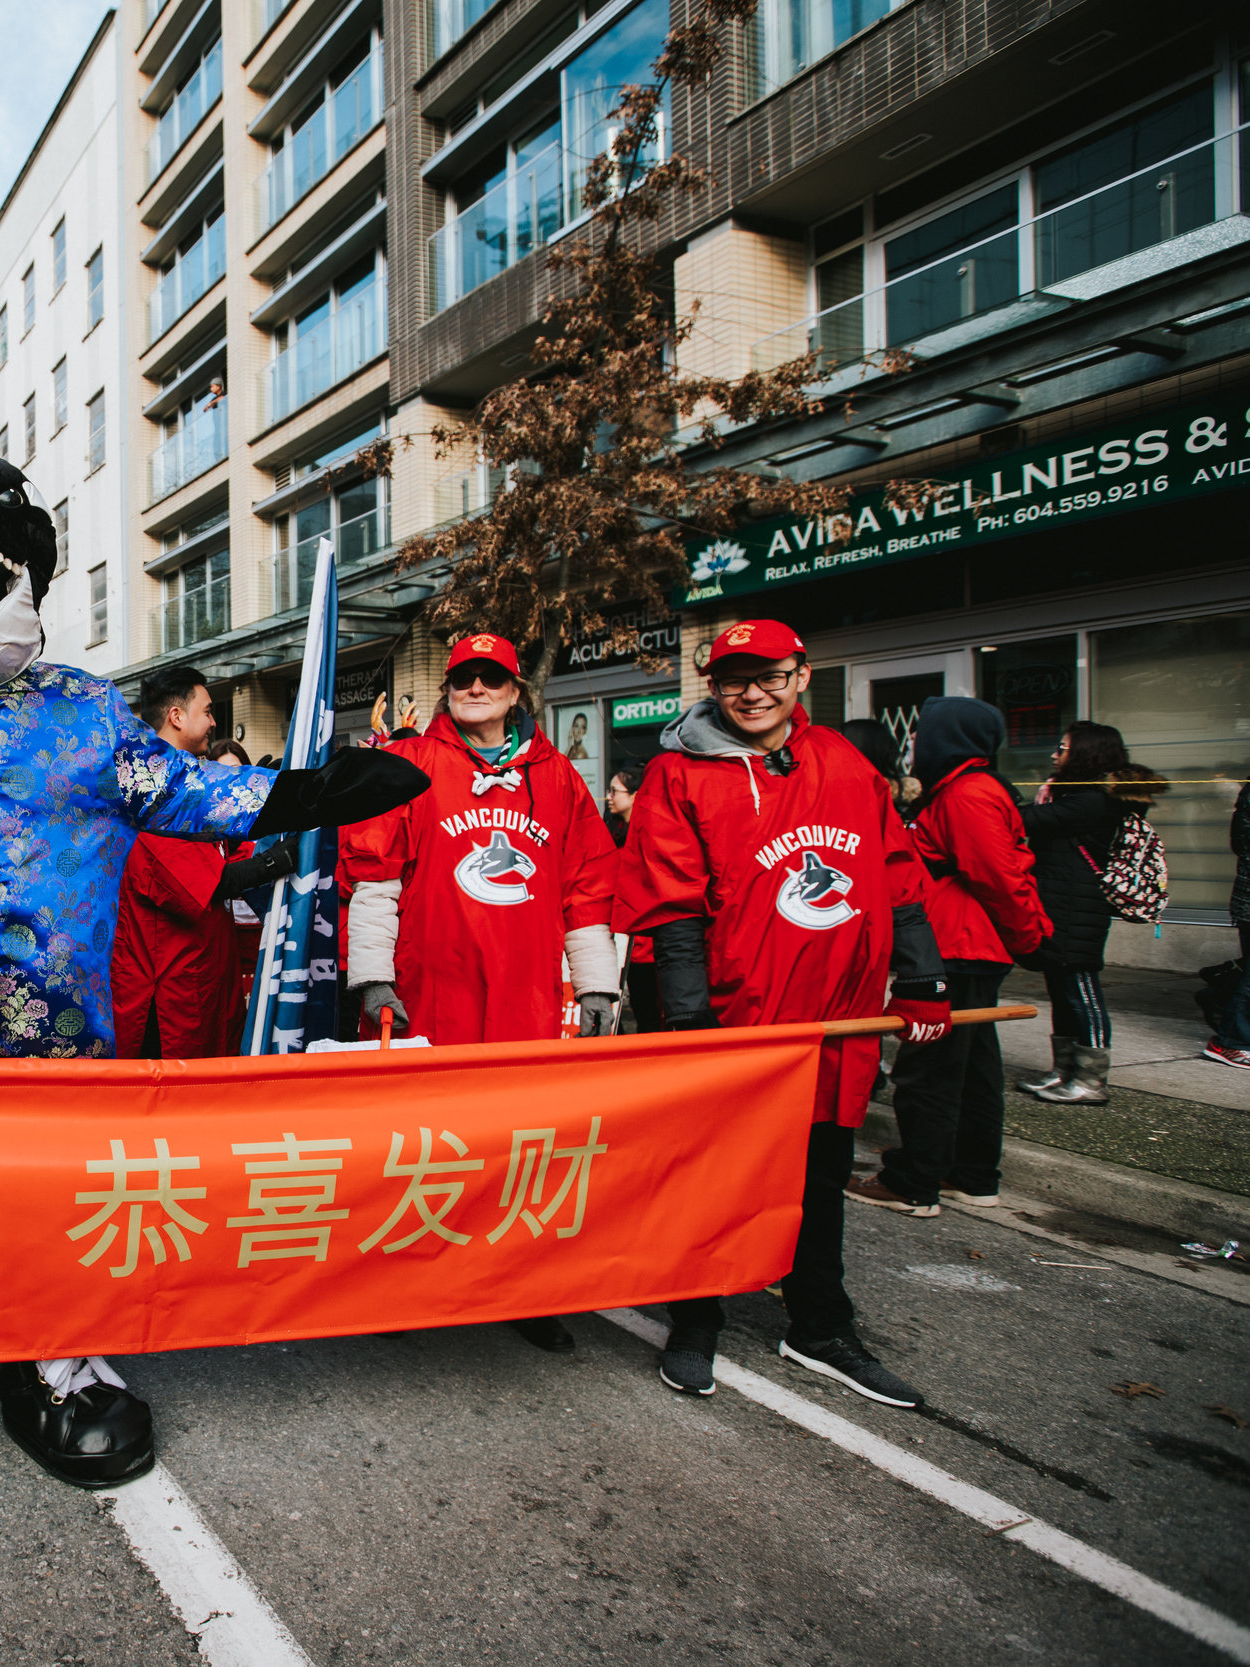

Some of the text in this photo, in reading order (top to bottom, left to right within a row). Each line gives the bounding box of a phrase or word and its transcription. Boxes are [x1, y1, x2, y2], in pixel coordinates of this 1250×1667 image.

[1184, 416, 1228, 453] &
[886, 526, 962, 554] BREATHE
[1013, 474, 1170, 524] 604.559.9216
[440, 808, 550, 847] VANCOUVER
[755, 825, 861, 870] VANCOUVER
[908, 1021, 946, 1042] CAN
[65, 1115, 608, 1278] 恭喜发财
